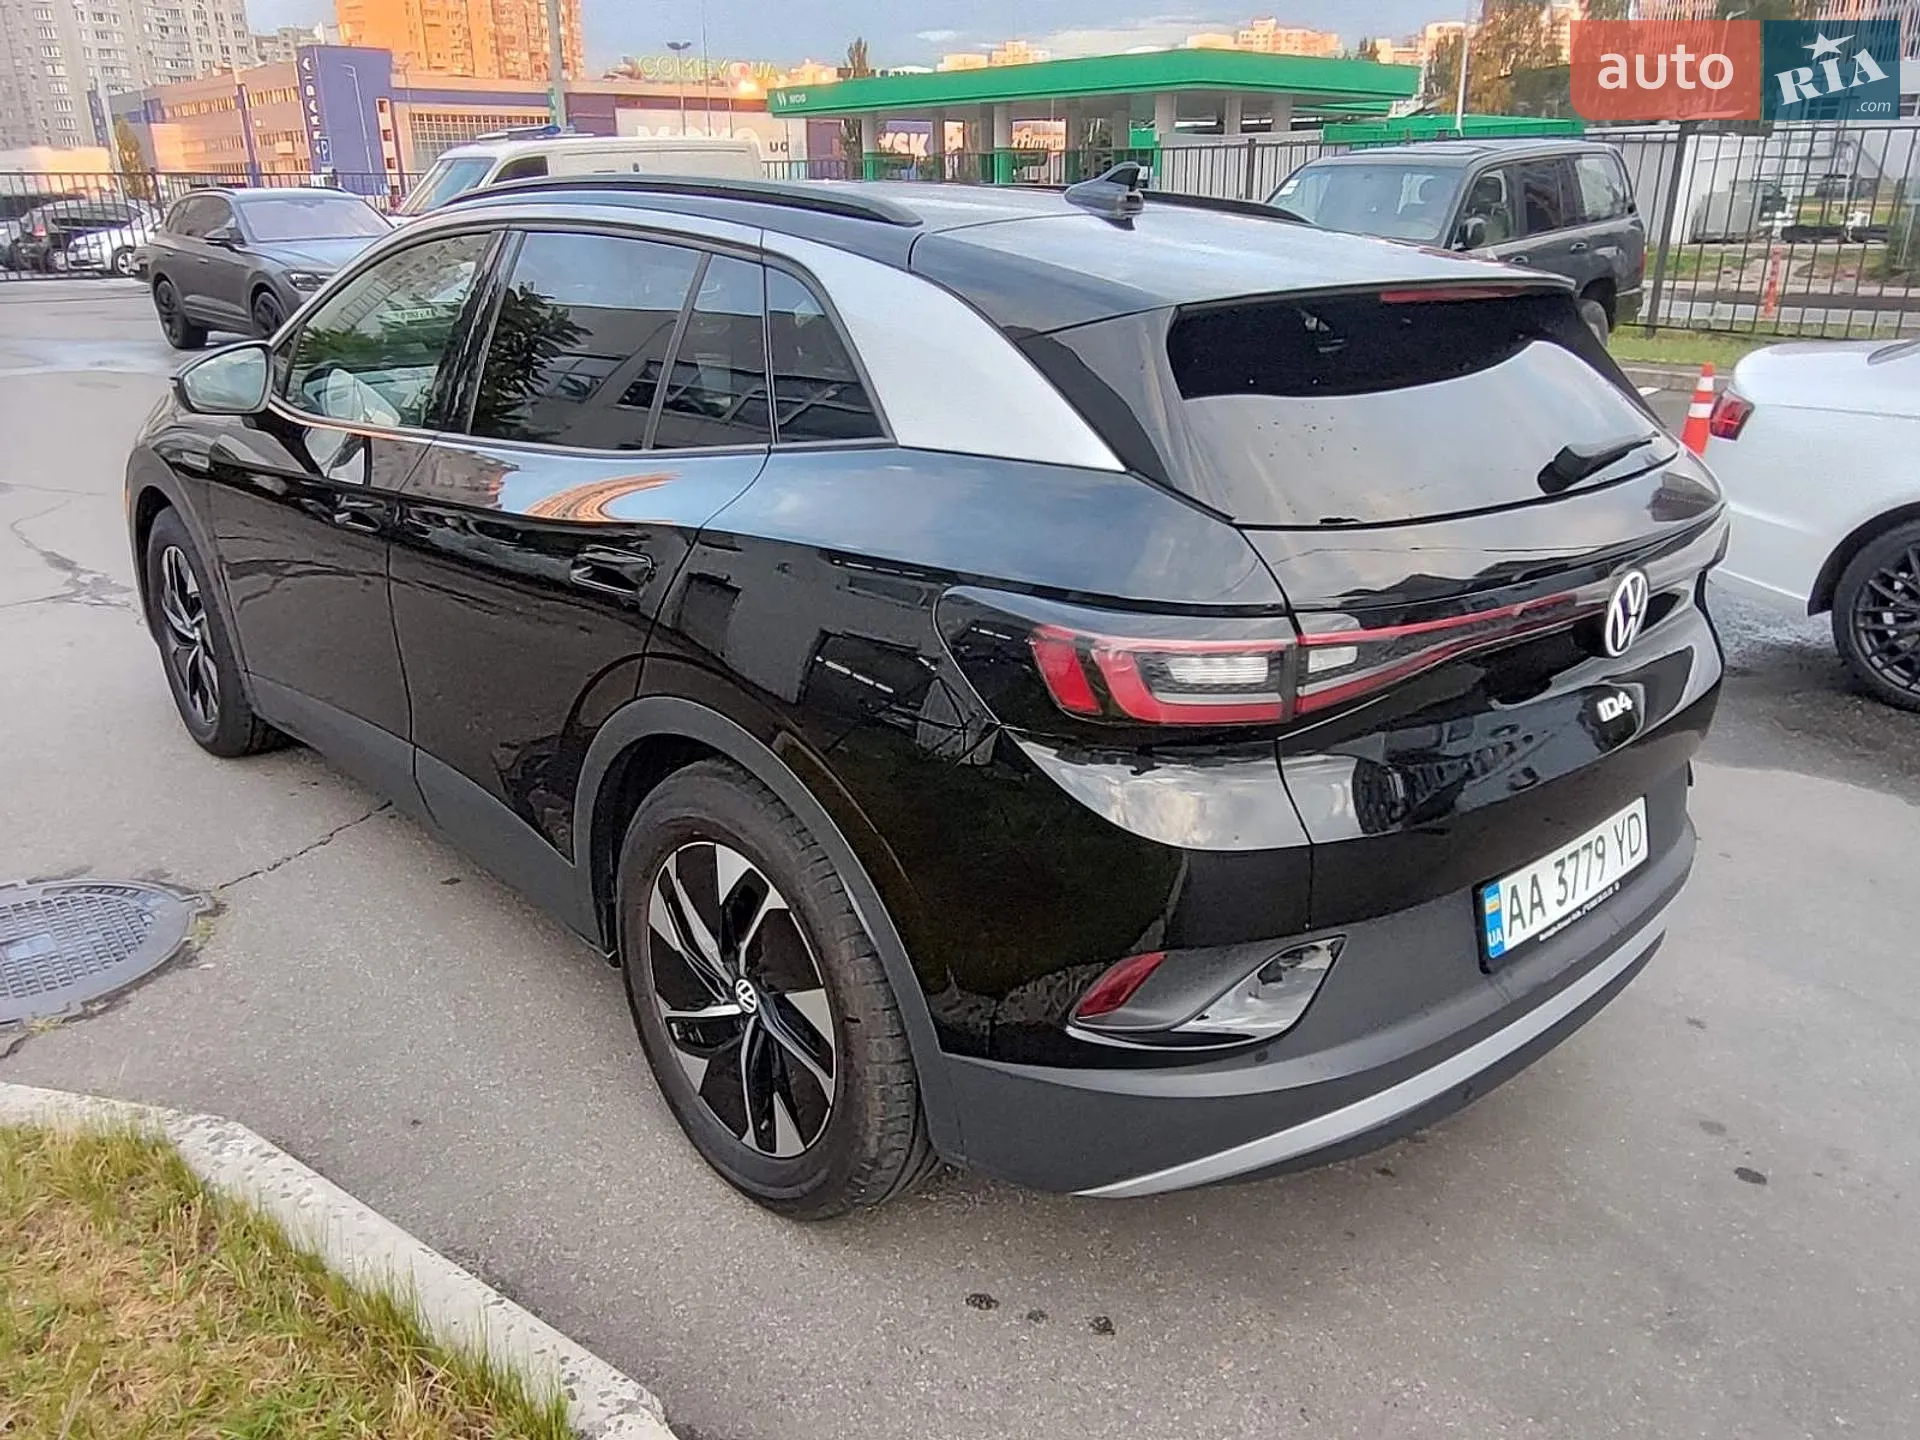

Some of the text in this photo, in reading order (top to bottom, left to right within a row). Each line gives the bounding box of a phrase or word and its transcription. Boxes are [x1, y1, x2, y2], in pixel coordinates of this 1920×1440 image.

[1507, 873, 1547, 938] AA
[1553, 834, 1606, 908] 3779
[1613, 811, 1642, 867] YD
[1487, 928, 1505, 944] UA
